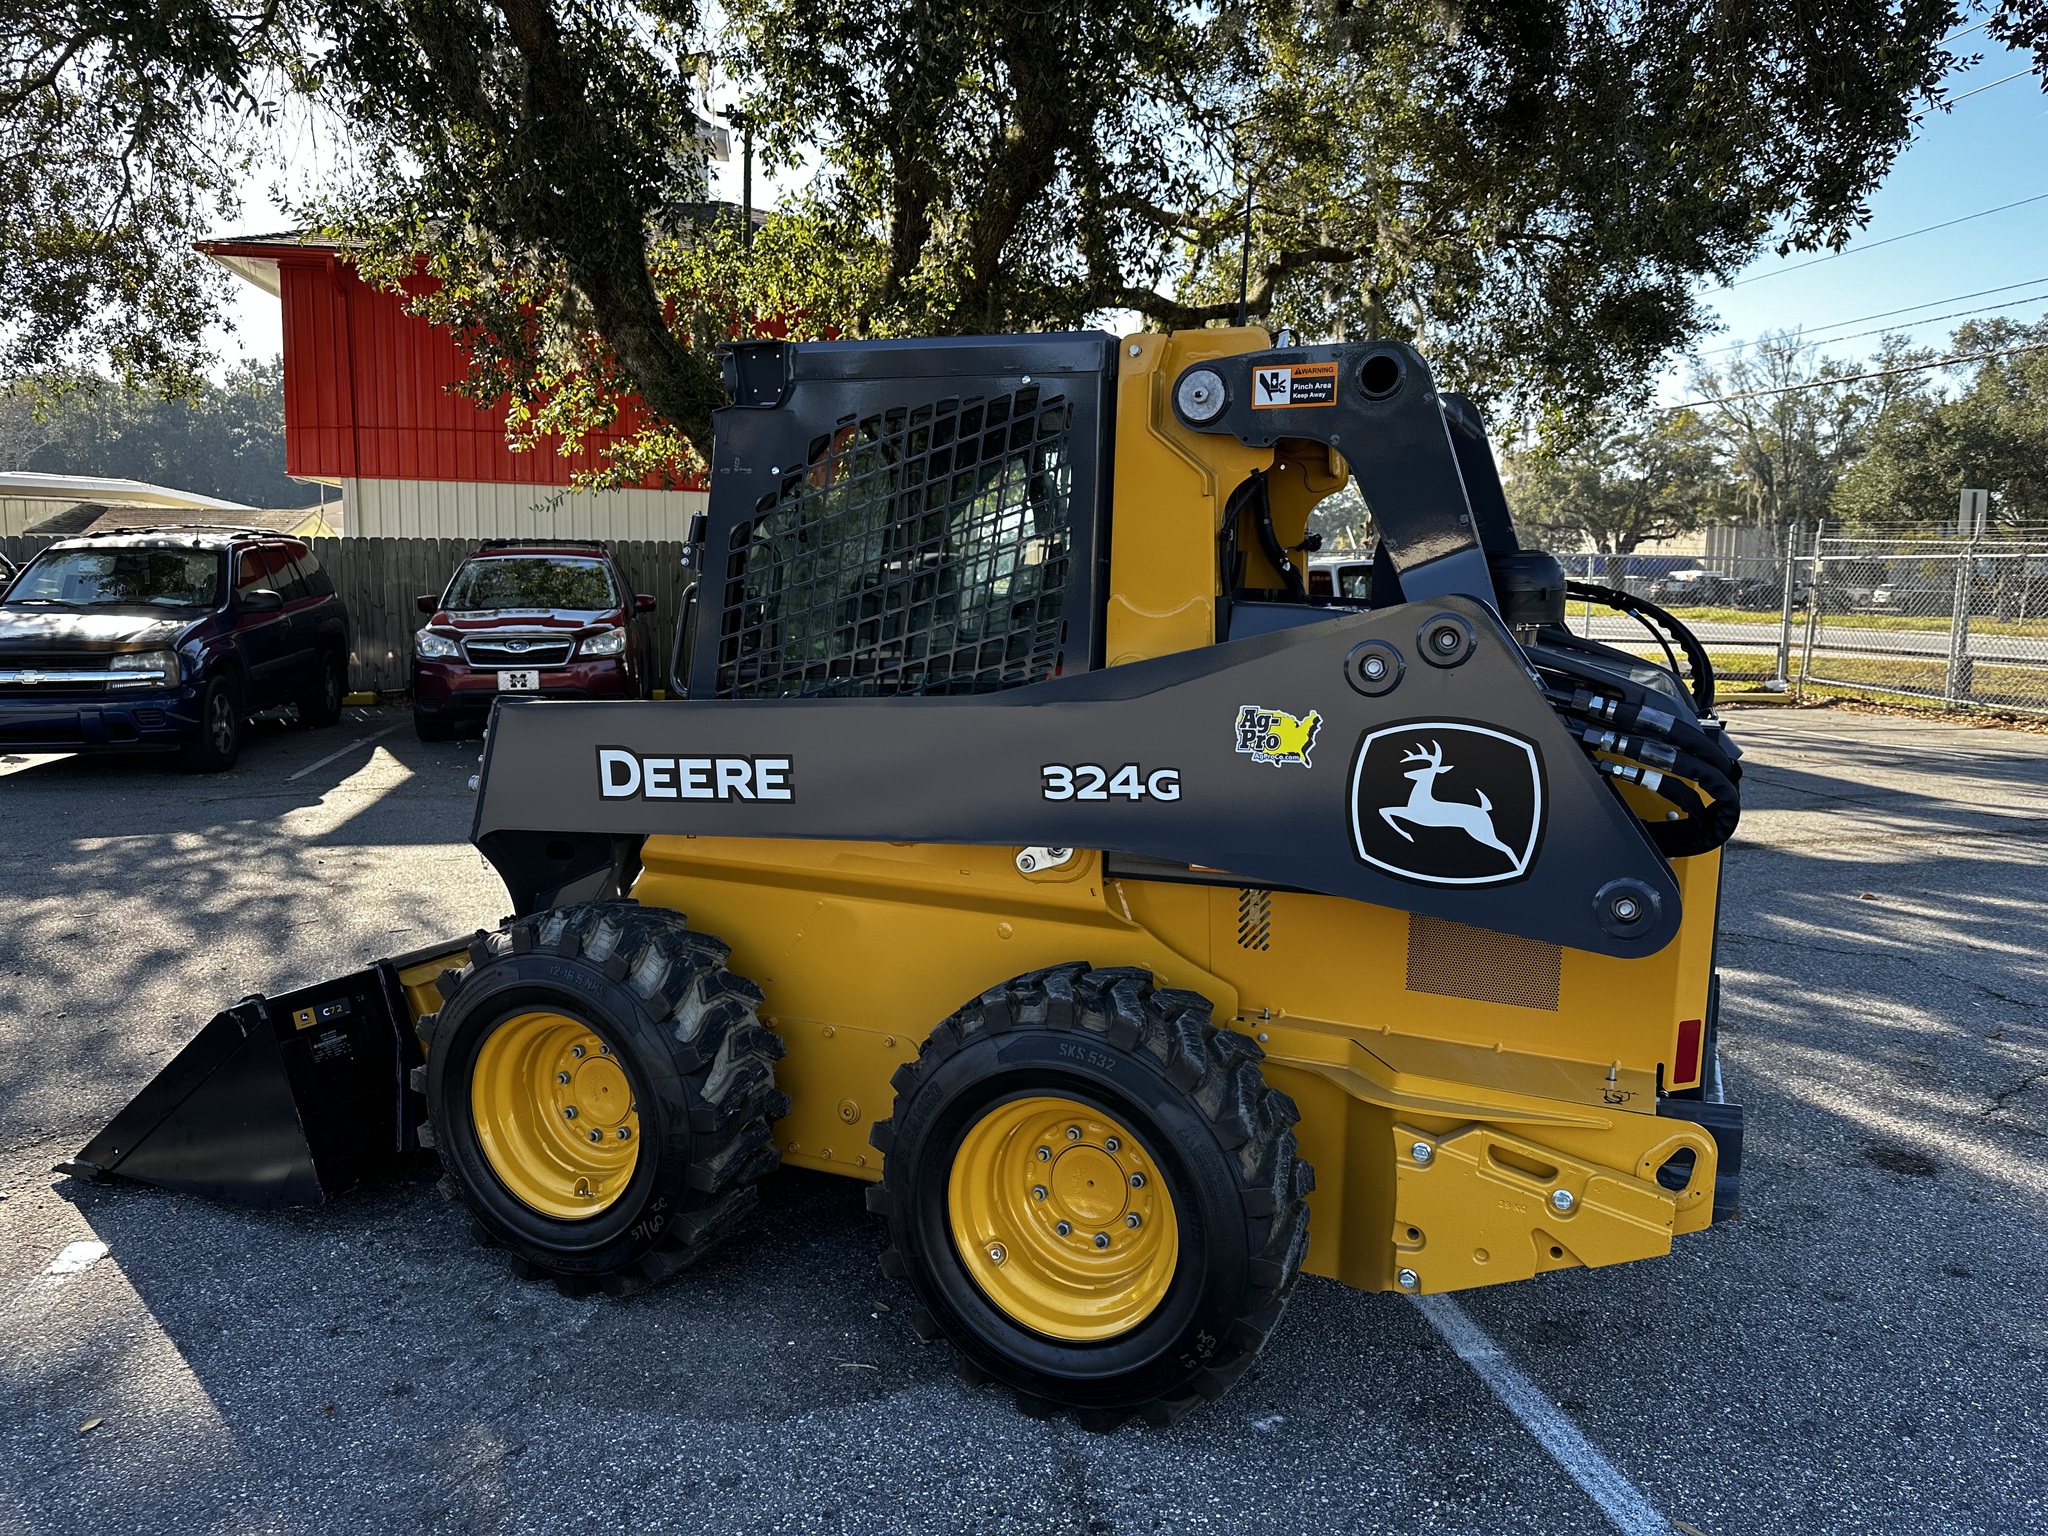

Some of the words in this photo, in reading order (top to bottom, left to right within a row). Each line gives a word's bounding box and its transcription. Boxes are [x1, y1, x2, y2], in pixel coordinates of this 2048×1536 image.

[1301, 366, 1334, 374] WARNING
[1239, 709, 1280, 733] Ag-
[1239, 729, 1280, 750] Pro
[1254, 753, 1301, 761] AgProCo.com
[600, 750, 792, 800] DEERE
[1043, 765, 1181, 801] 324G
[322, 1004, 343, 1016] C72
[1059, 1042, 1087, 1061] SKS
[1087, 1050, 1117, 1073] 532
